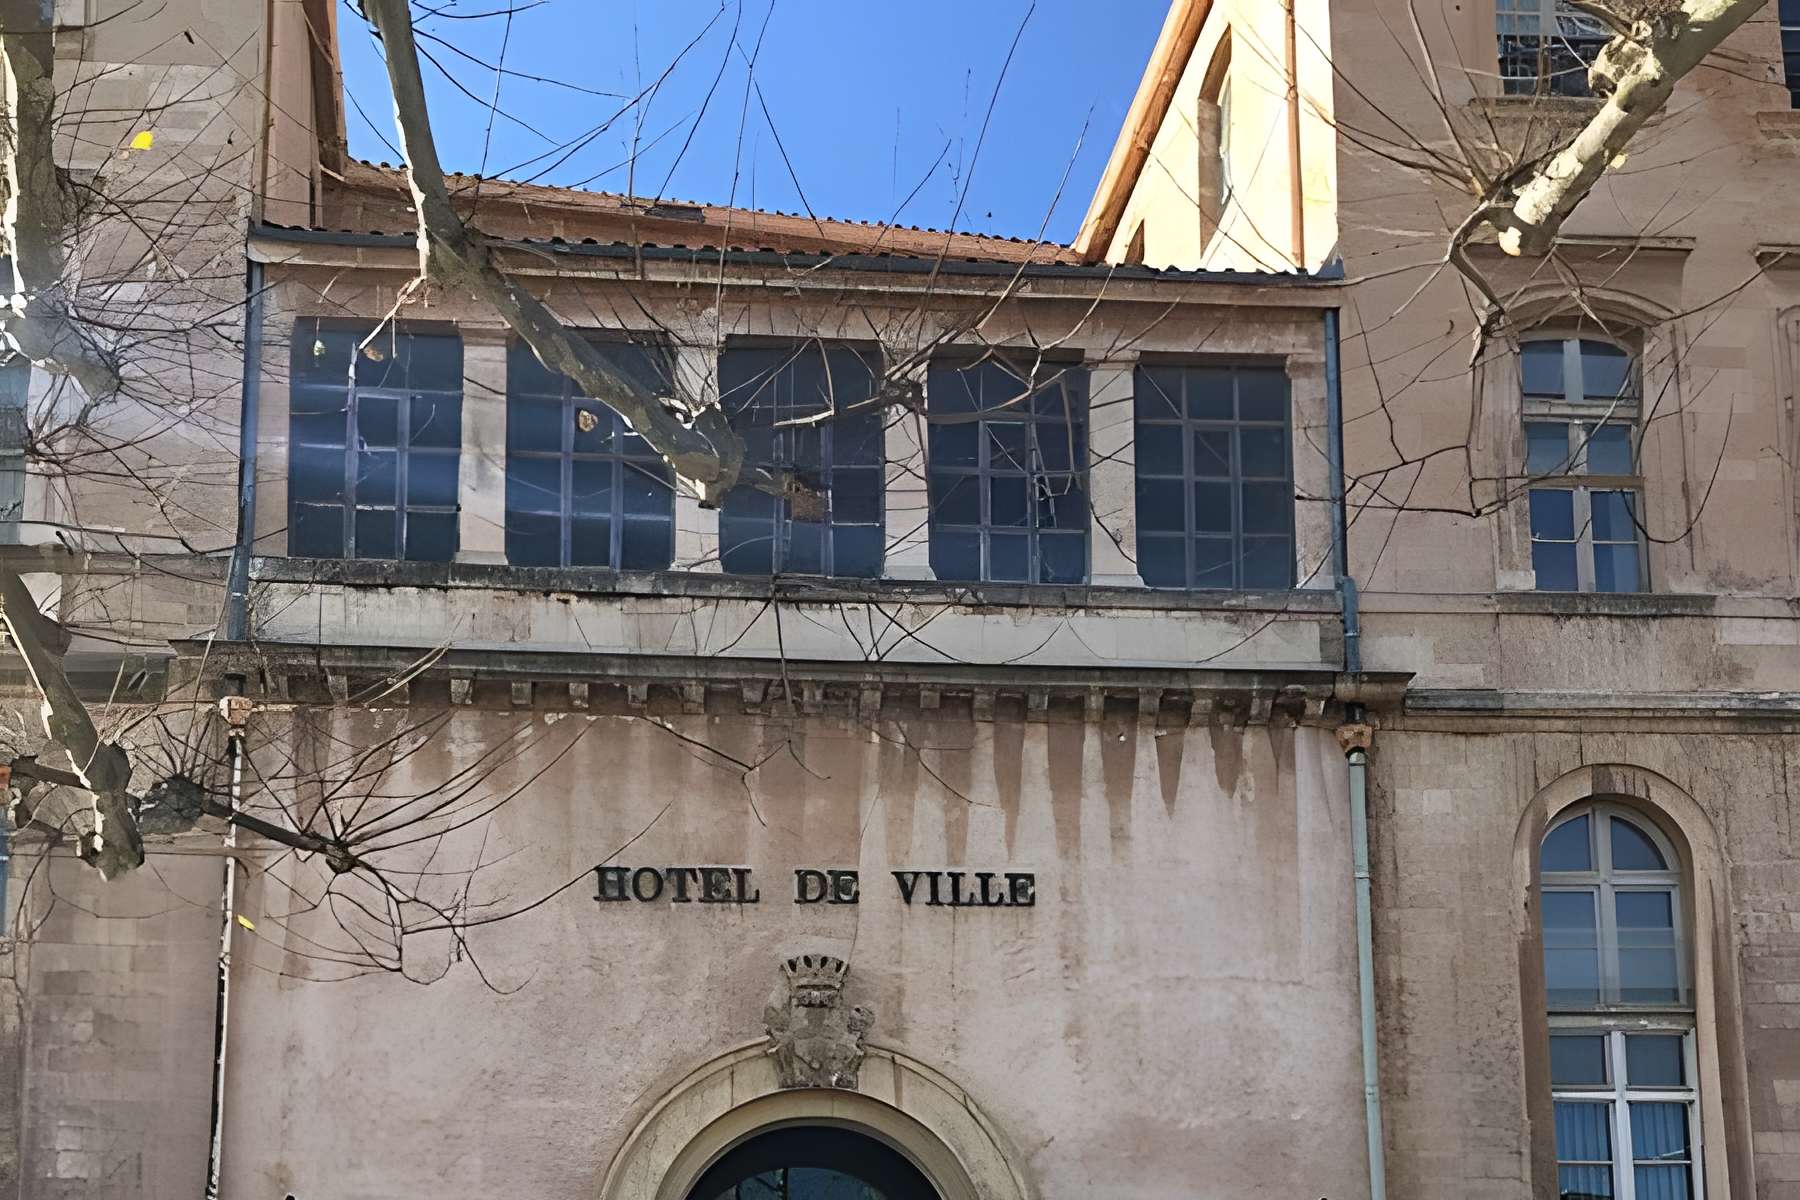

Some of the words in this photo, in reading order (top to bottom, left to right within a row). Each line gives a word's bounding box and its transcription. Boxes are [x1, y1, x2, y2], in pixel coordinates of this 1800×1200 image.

[593, 866, 760, 904] HOTEL
[794, 869, 860, 904] DE
[891, 871, 1036, 907] VILLE
